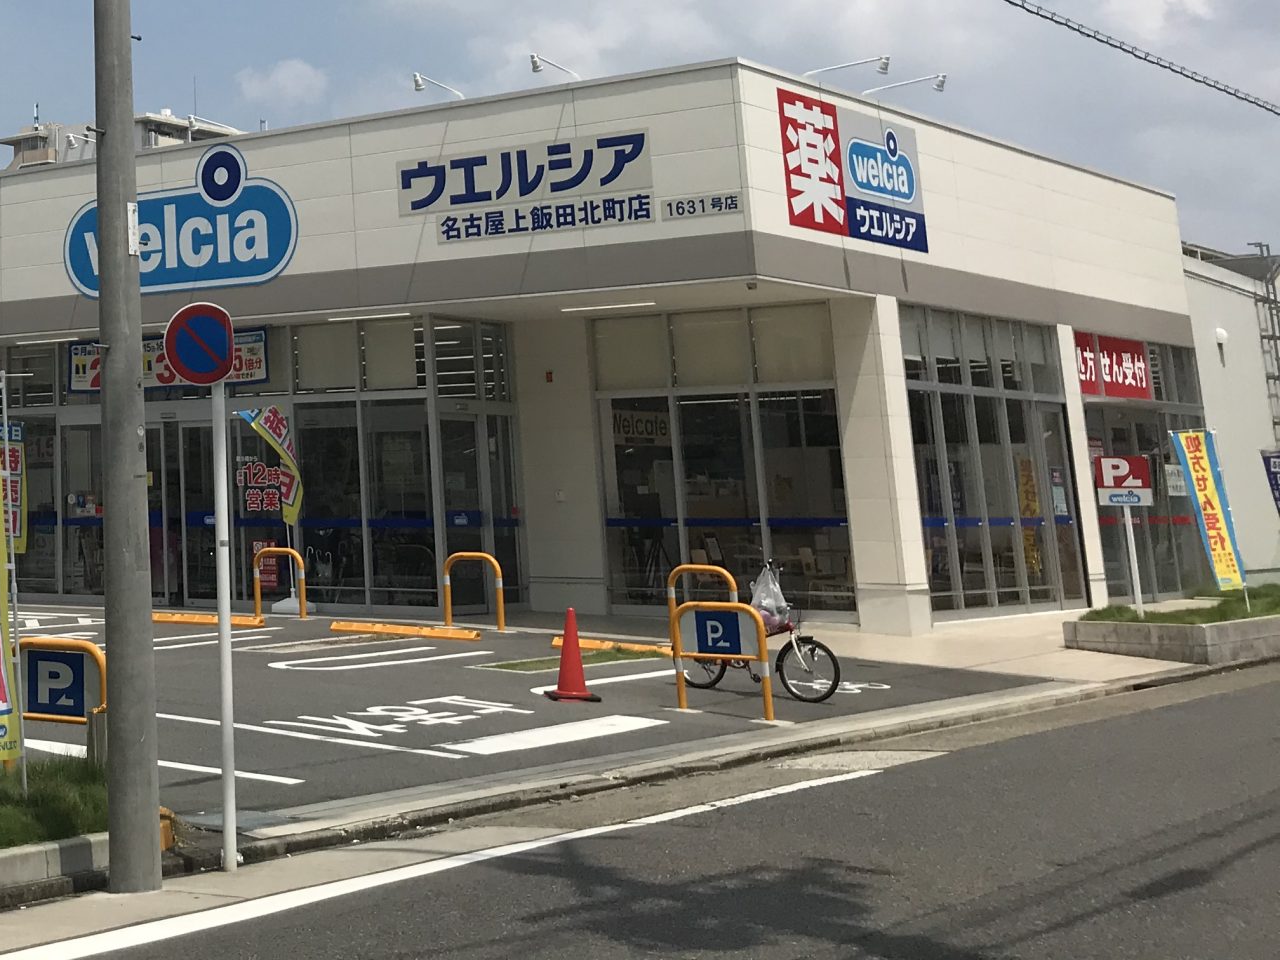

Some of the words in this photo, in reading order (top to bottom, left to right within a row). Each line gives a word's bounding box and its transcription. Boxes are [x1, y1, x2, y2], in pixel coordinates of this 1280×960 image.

[400, 132, 646, 211] ウエルシア
[783, 101, 845, 225] 薬
[852, 151, 910, 194] welcia
[440, 194, 652, 241] 名古屋上飯田北町店
[666, 195, 739, 218] 1631号店
[855, 205, 917, 243] ウエルシア
[83, 202, 269, 277] elcia
[246, 488, 281, 512] 営業
